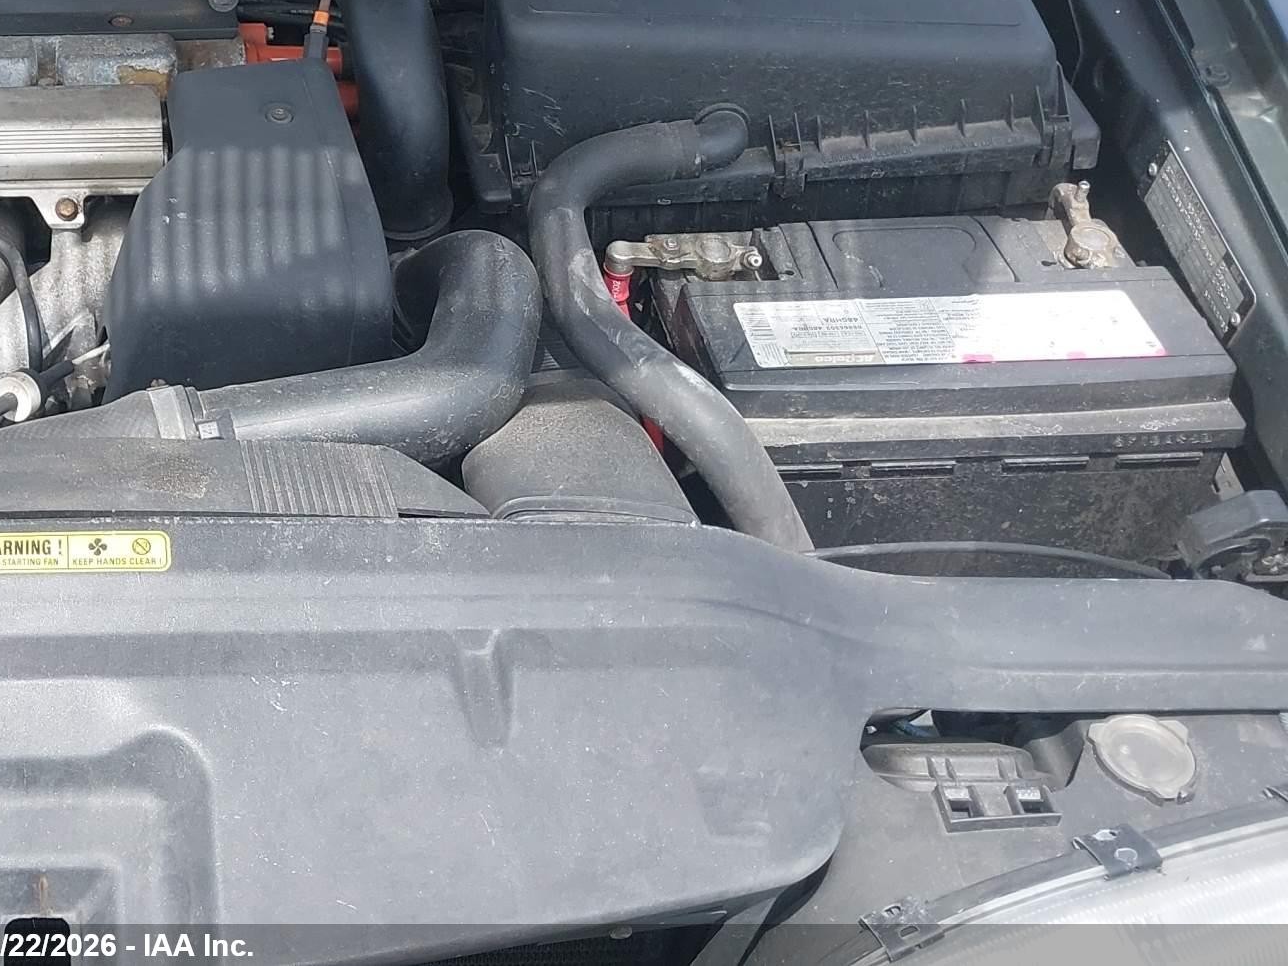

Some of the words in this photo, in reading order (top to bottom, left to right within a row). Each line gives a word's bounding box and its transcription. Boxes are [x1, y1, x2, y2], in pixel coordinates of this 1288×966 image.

[58, 539, 63, 555] !
[2, 557, 41, 566] STARTING
[43, 557, 59, 566] FAN
[72, 557, 94, 566] KEEP
[96, 557, 127, 565] HANDS
[129, 557, 157, 565] CLEAR
